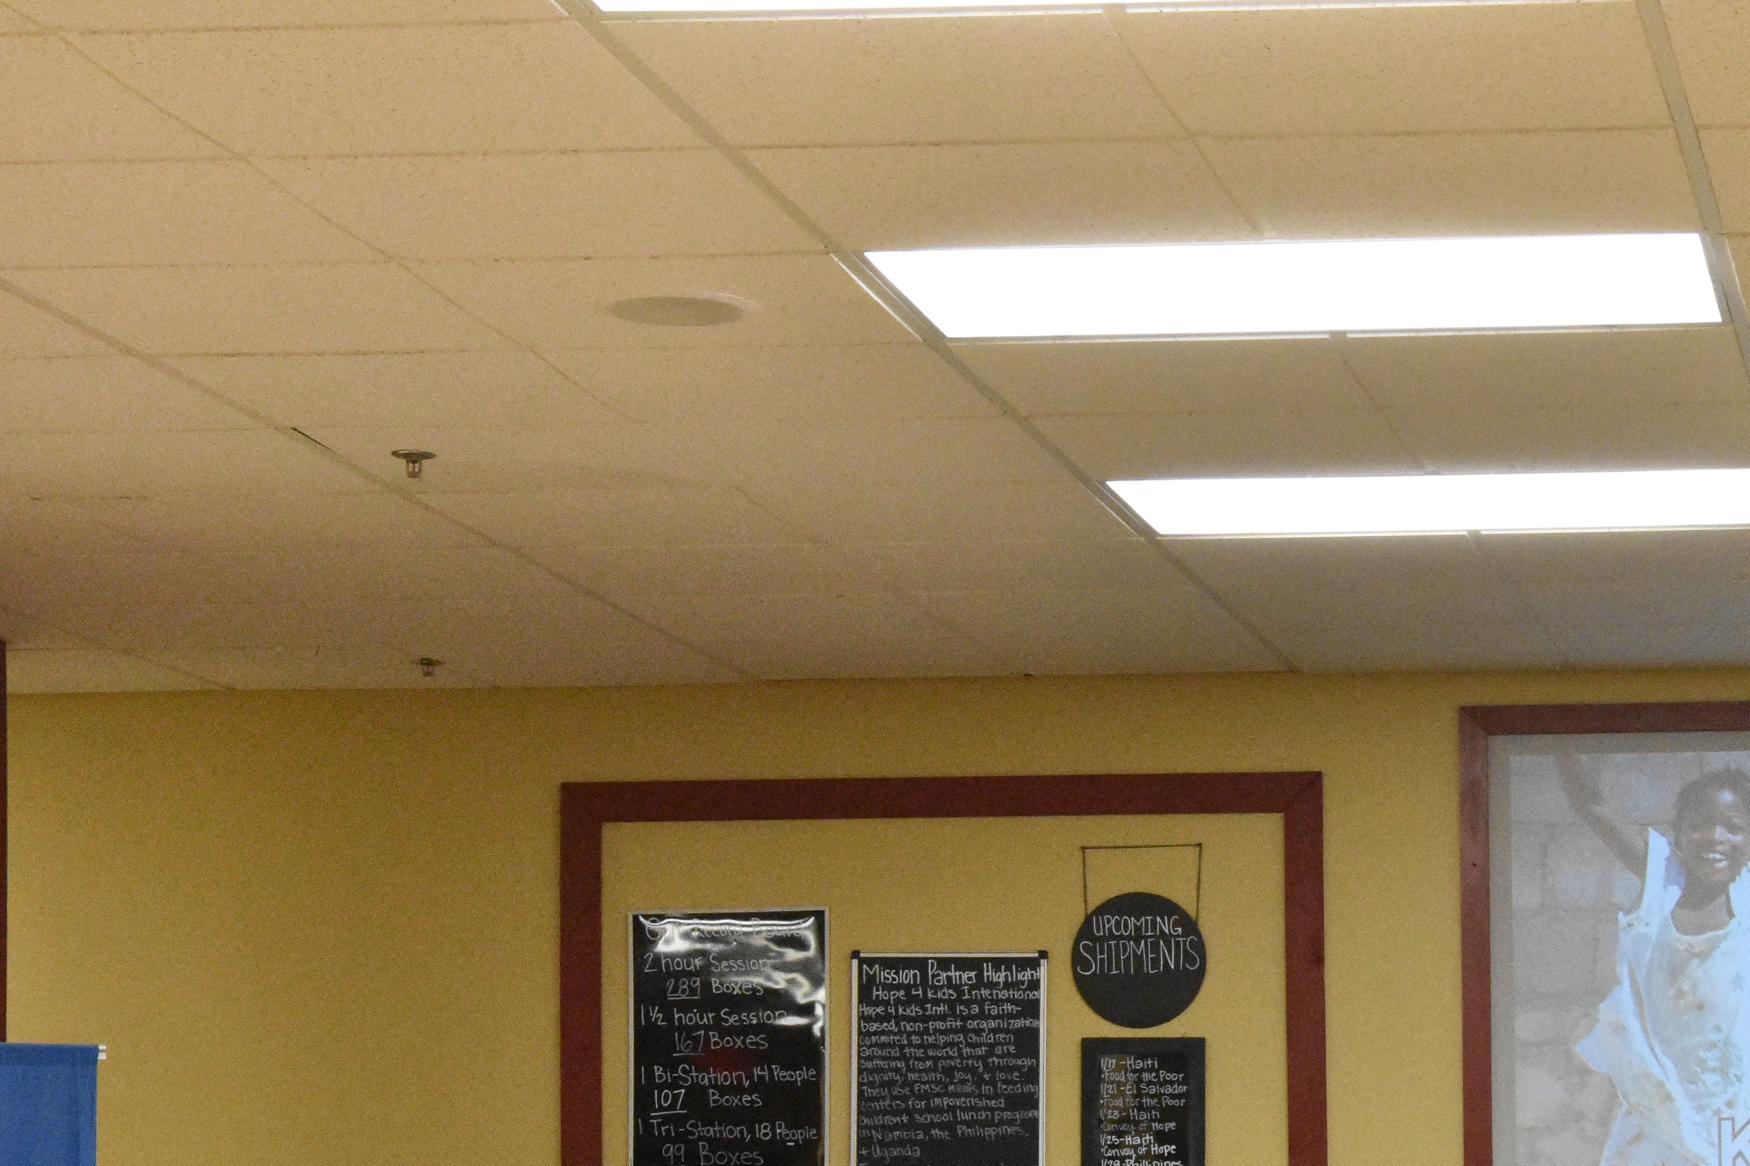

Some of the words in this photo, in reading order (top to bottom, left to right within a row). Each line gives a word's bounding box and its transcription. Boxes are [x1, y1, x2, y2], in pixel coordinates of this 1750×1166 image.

[1093, 915, 1182, 936] UPCOMING
[644, 953, 657, 972] 2
[661, 956, 702, 972] hour
[710, 953, 771, 972] Session
[1077, 936, 1200, 975] SHIPMENTS
[862, 964, 921, 985] Mission
[928, 960, 977, 986] Partner
[984, 963, 1040, 988] Highlight
[667, 978, 701, 998] 289
[711, 978, 764, 996] Boxes
[873, 986, 906, 1003] Hope
[912, 986, 922, 999] 4
[674, 1006, 716, 1026] hour
[720, 1008, 788, 1026] Session
[860, 1004, 885, 1018] Hope
[888, 1005, 895, 1016] 4
[956, 1003, 968, 1015] is
[970, 1005, 979, 1015] a
[984, 1001, 1022, 1015] faith-
[860, 1020, 898, 1033] based,
[901, 1018, 964, 1034] non-profit
[966, 1018, 1040, 1034] organization
[676, 1031, 705, 1052] 167
[710, 1031, 769, 1049] Boxes
[910, 1033, 921, 1045] to
[923, 1033, 964, 1050] helping
[860, 1046, 900, 1057] around
[903, 1045, 924, 1057] the
[927, 1045, 958, 1056] world
[963, 1045, 987, 1056] that
[994, 1045, 1016, 1055] are
[909, 1058, 934, 1070] from
[938, 1058, 983, 1074] poverty
[654, 1064, 750, 1088] Bi-Station,
[754, 1065, 769, 1082] 14
[773, 1065, 817, 1086] People
[1141, 1070, 1158, 1082] the
[1159, 1070, 1185, 1081] Poor
[861, 1086, 890, 1101] They
[891, 1086, 911, 1095] use
[998, 1081, 1039, 1098] feeding
[1140, 1083, 1189, 1095] Salvador
[654, 1089, 686, 1109] 107
[708, 1089, 763, 1108] Boxes
[908, 1097, 927, 1109] for
[1141, 1096, 1160, 1108] the
[1161, 1095, 1187, 1107] Poor
[914, 1111, 953, 1123] school
[957, 1109, 991, 1121] lunch
[755, 1123, 772, 1140] 18
[776, 1121, 818, 1145] People
[930, 1128, 951, 1139] the
[1151, 1121, 1177, 1132] Hope
[662, 1144, 685, 1164] 99
[699, 1142, 764, 1166] Boxes
[871, 1145, 921, 1163] Uganda
[1103, 1145, 1136, 1159] Convoy
[1151, 1143, 1177, 1156] Hope
